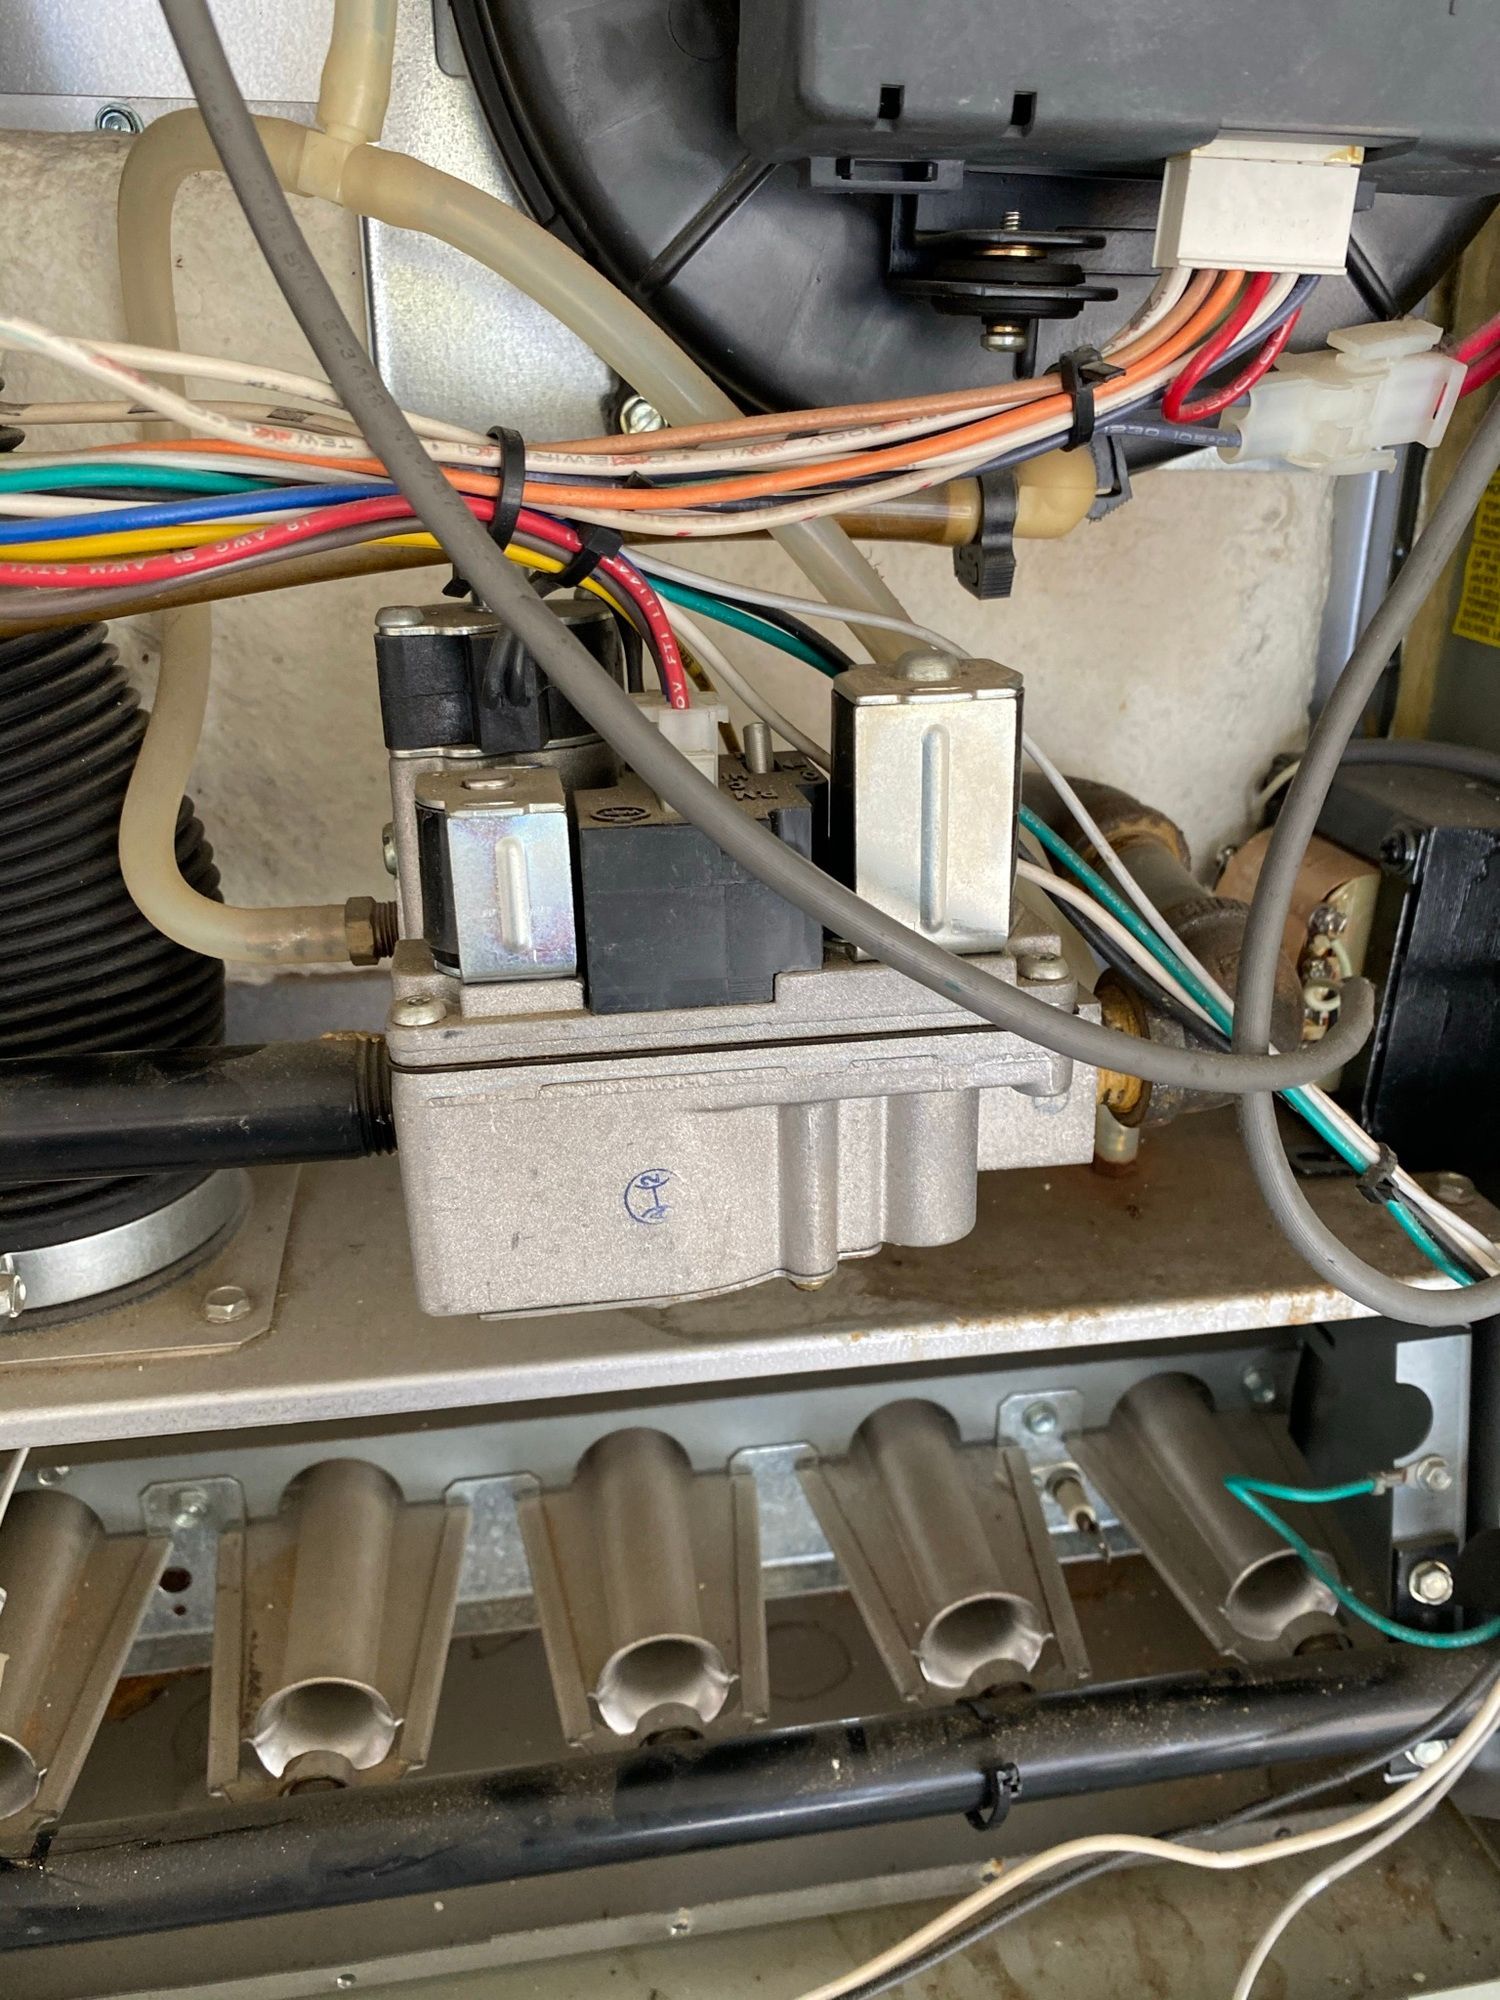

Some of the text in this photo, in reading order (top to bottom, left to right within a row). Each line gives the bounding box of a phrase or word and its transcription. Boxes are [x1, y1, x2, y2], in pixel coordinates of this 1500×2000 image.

[289, 431, 353, 452] TEW
[287, 519, 312, 532] 18
[215, 530, 267, 553] AWG
[89, 560, 146, 575] AWM
